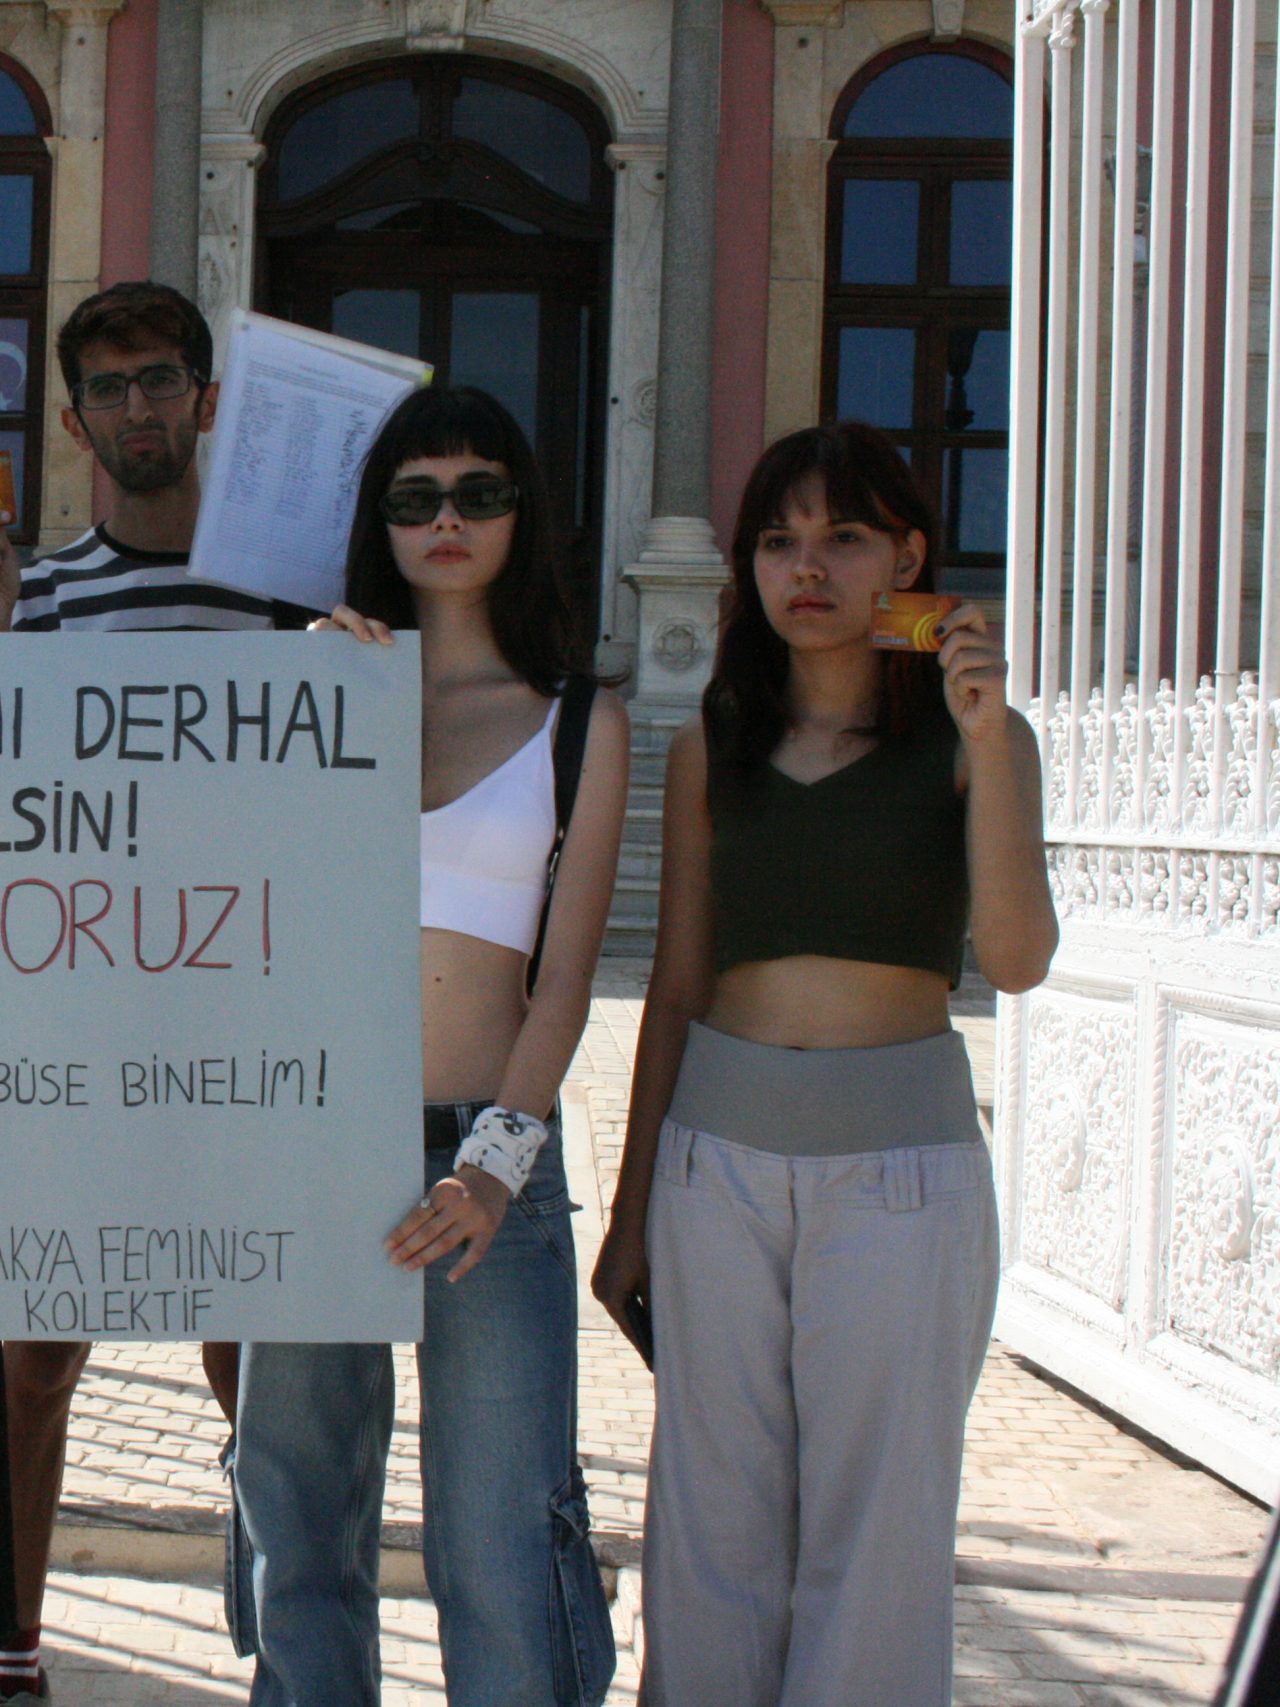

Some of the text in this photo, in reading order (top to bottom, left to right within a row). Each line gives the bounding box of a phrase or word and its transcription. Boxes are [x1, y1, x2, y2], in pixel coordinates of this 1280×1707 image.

[74, 679, 377, 771] DERHAL
[121, 1048, 327, 1109] BİNELİM!
[98, 1226, 295, 1284] FEMİNİST
[24, 1288, 214, 1333] KOLEKTİF
